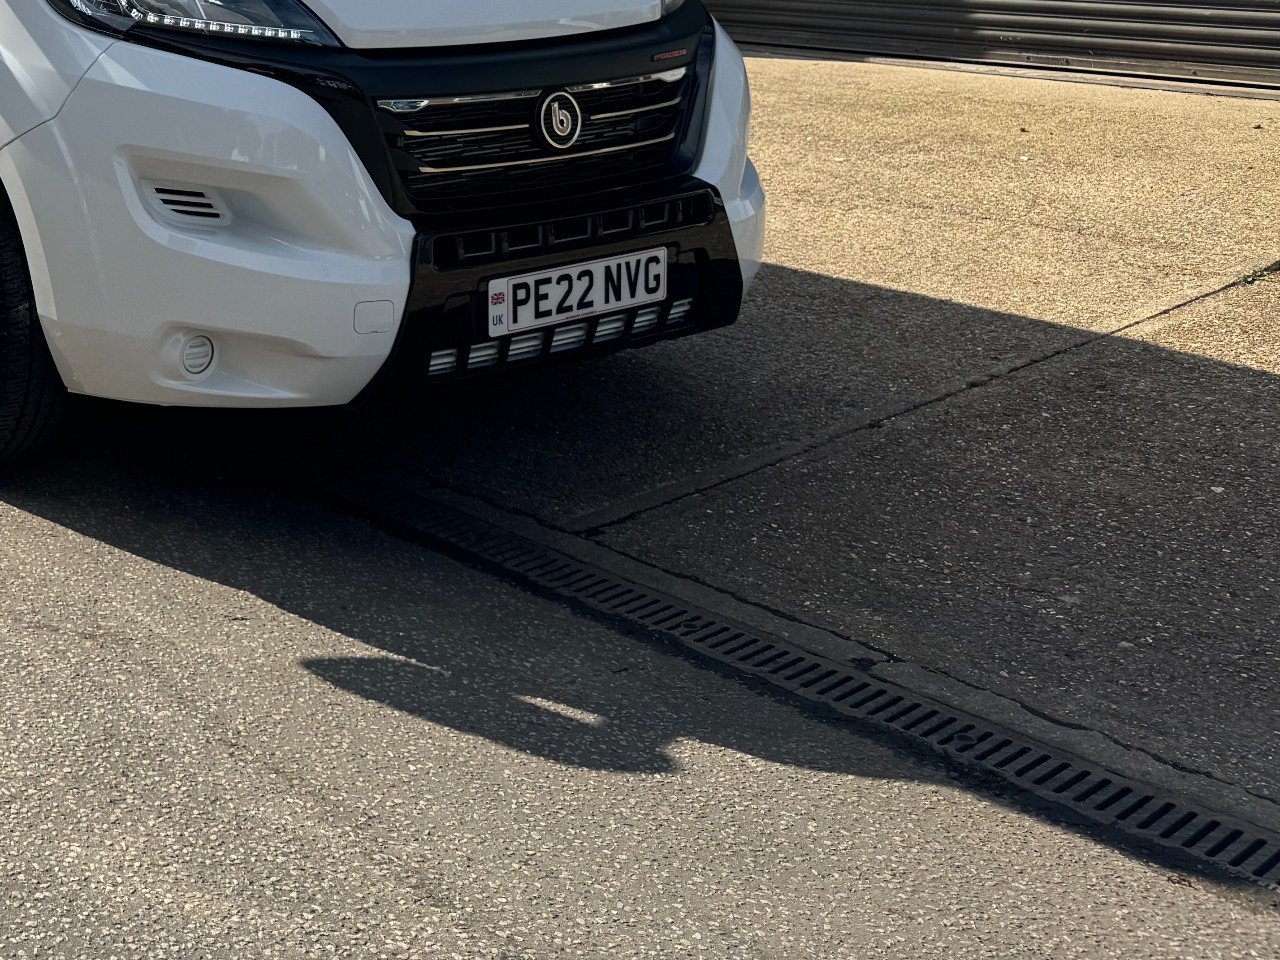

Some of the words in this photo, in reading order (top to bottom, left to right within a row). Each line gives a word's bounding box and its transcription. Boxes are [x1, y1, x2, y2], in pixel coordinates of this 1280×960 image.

[512, 269, 594, 324] PE22
[604, 255, 661, 304] NVG
[492, 314, 504, 326] UK
